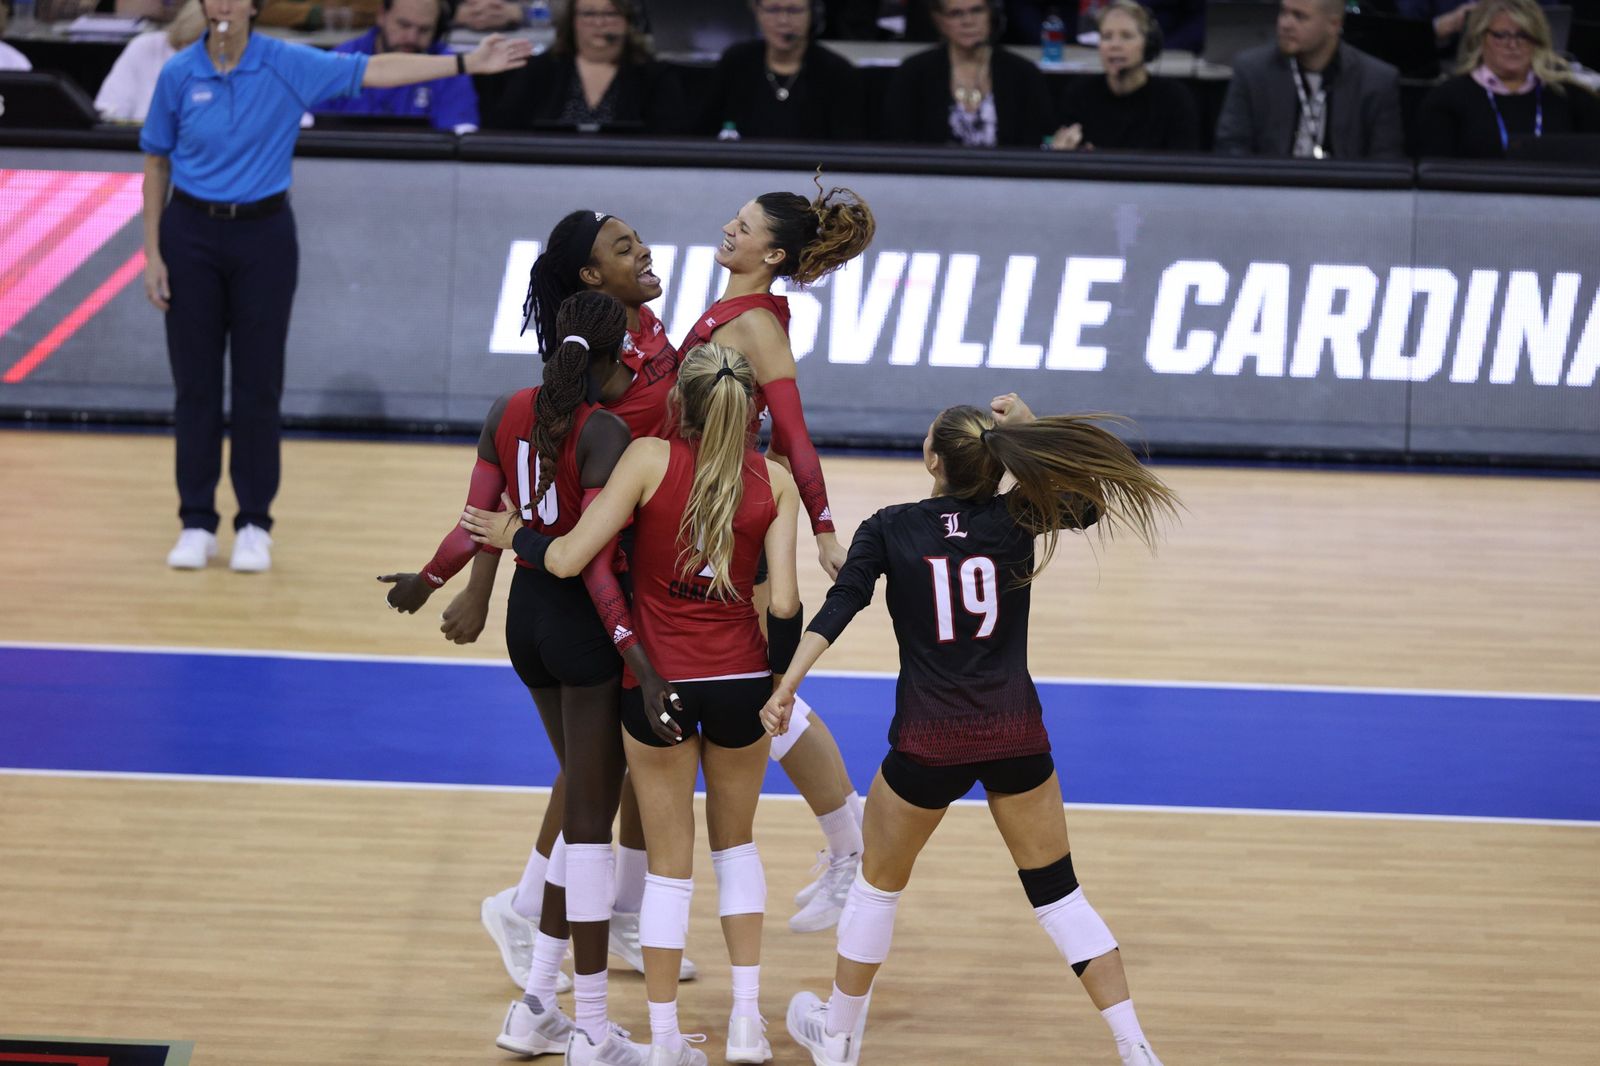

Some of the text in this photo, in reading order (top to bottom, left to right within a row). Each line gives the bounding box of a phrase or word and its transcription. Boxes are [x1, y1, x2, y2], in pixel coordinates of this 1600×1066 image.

[489, 240, 1126, 371] LUSVILLE
[940, 511, 968, 539] L
[923, 555, 998, 643] 19
